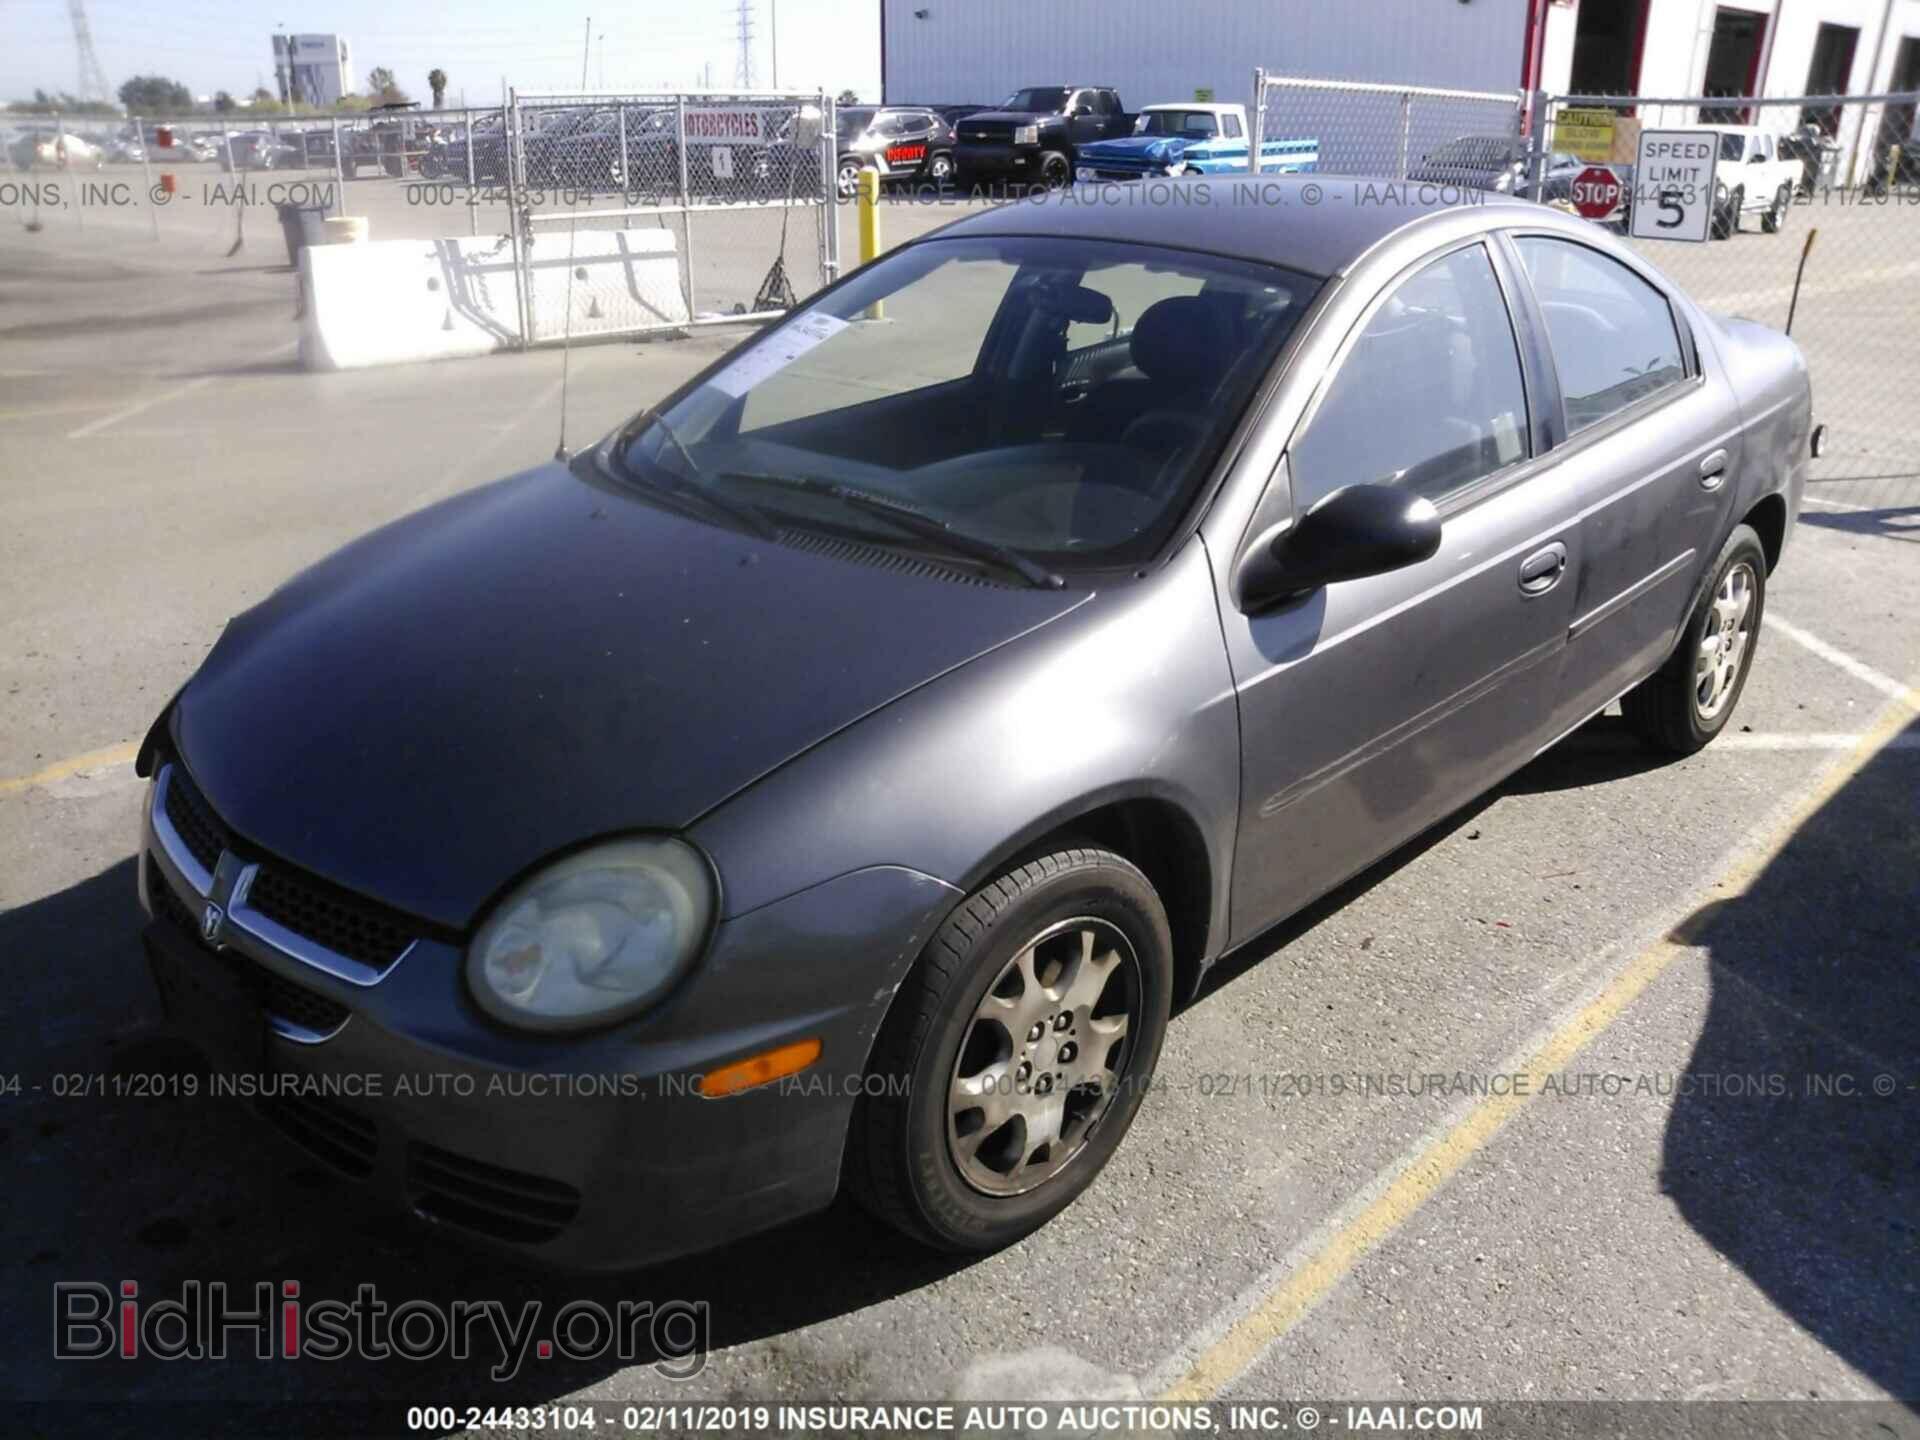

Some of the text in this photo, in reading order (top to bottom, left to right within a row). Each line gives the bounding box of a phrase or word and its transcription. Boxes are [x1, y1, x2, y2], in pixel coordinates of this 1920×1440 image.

[1646, 142, 1711, 159] SPEED
[1650, 167, 1701, 182] LIMIT
[1573, 181, 1618, 205] STOP
[1656, 190, 1684, 229] 5
